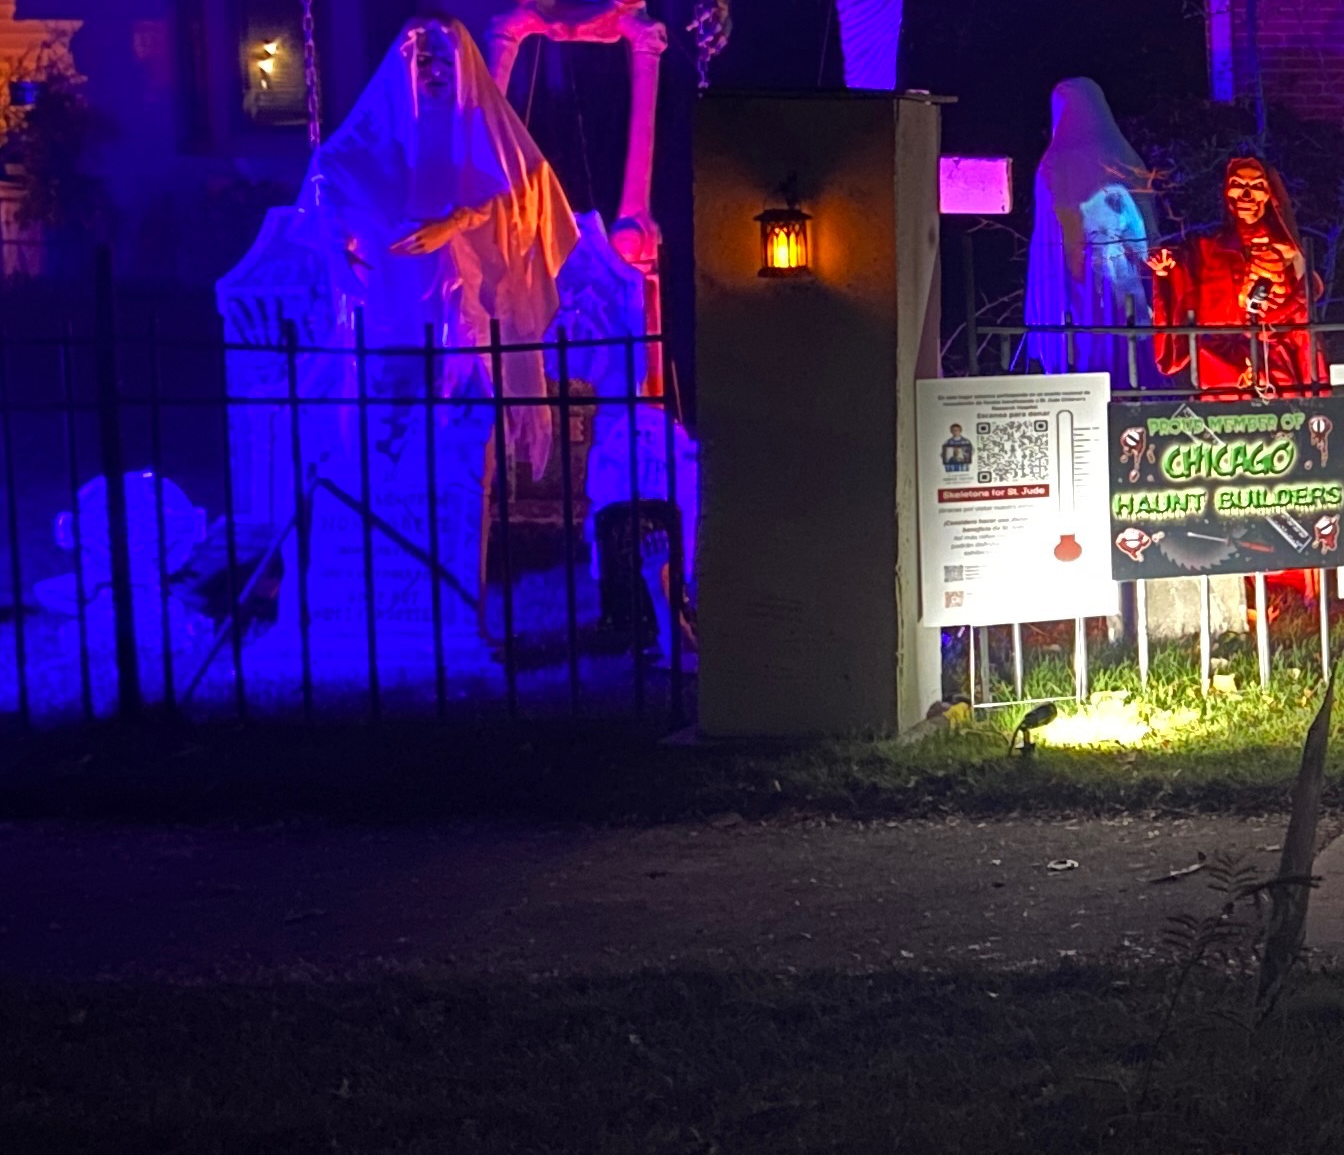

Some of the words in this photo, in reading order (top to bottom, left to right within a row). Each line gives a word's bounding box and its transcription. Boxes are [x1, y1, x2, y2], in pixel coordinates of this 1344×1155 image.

[1147, 415, 1205, 437] PROUD
[1207, 413, 1277, 434] MEMBER
[1279, 412, 1306, 432] OF
[1164, 441, 1295, 479] CHICAGO
[942, 489, 990, 499] Skeletons
[991, 487, 1006, 497] for
[1006, 487, 1019, 497] St.
[1021, 486, 1046, 496] Jude
[1114, 490, 1206, 518] HAUNT
[1217, 484, 1343, 513] BUILDERS
